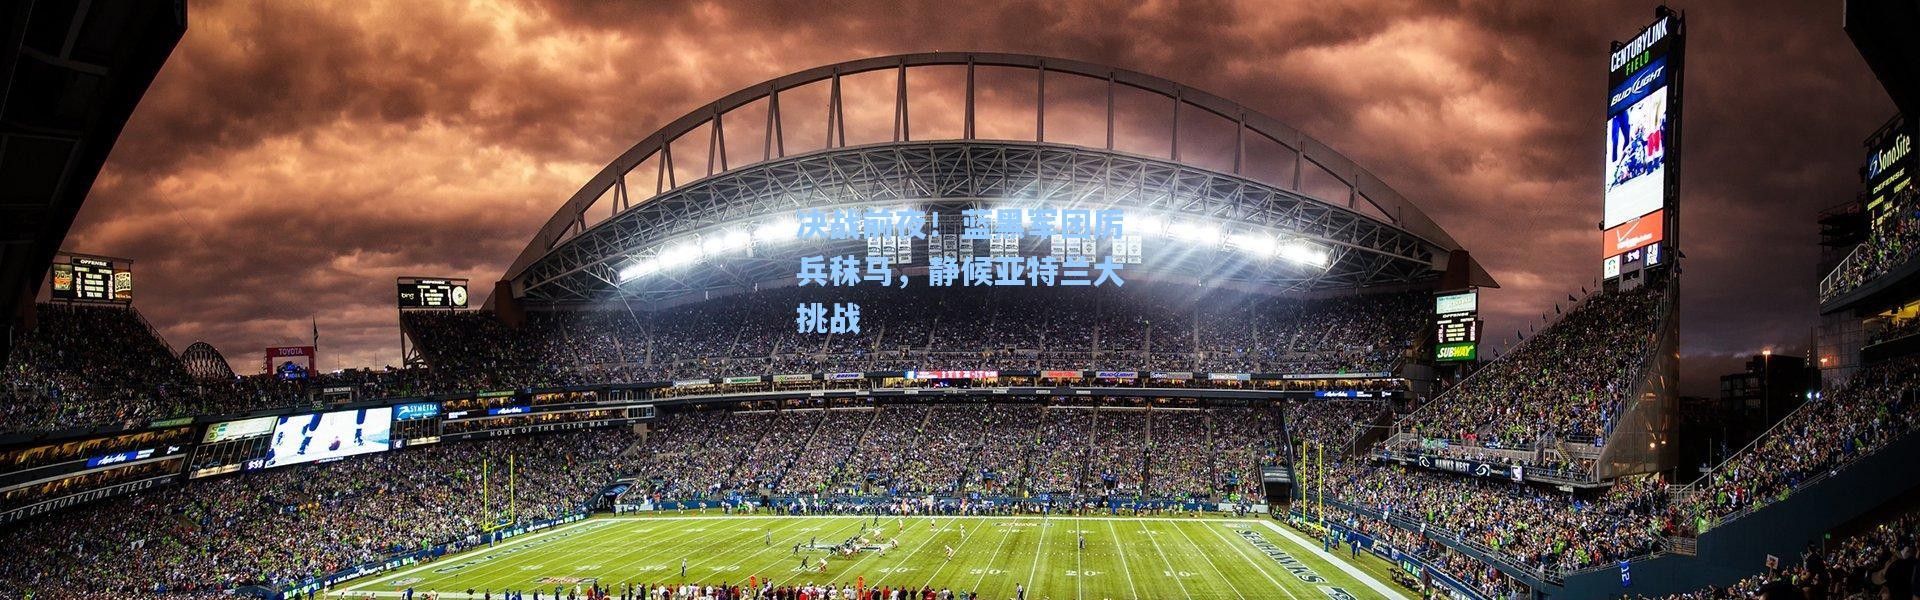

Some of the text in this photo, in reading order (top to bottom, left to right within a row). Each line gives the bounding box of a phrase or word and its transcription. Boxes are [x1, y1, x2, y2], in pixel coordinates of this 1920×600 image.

[1610, 15, 1668, 73] CENTURYLINK
[1625, 49, 1650, 77] FIELD
[1610, 65, 1664, 107] BUD LIGHT
[1878, 133, 1911, 174] SonoSite
[1873, 167, 1905, 195] DEFENSE
[1437, 345, 1474, 359] SUBWAY
[410, 404, 437, 413] SYMETRA
[490, 429, 515, 437] HOME
[561, 422, 583, 430] 12TH
[589, 420, 609, 428] MAN
[1434, 458, 1471, 473] HAWKS NEST
[9, 480, 153, 523] TO CENTURYLINK FIELD
[1234, 529, 1328, 584] SEAHAWKS
